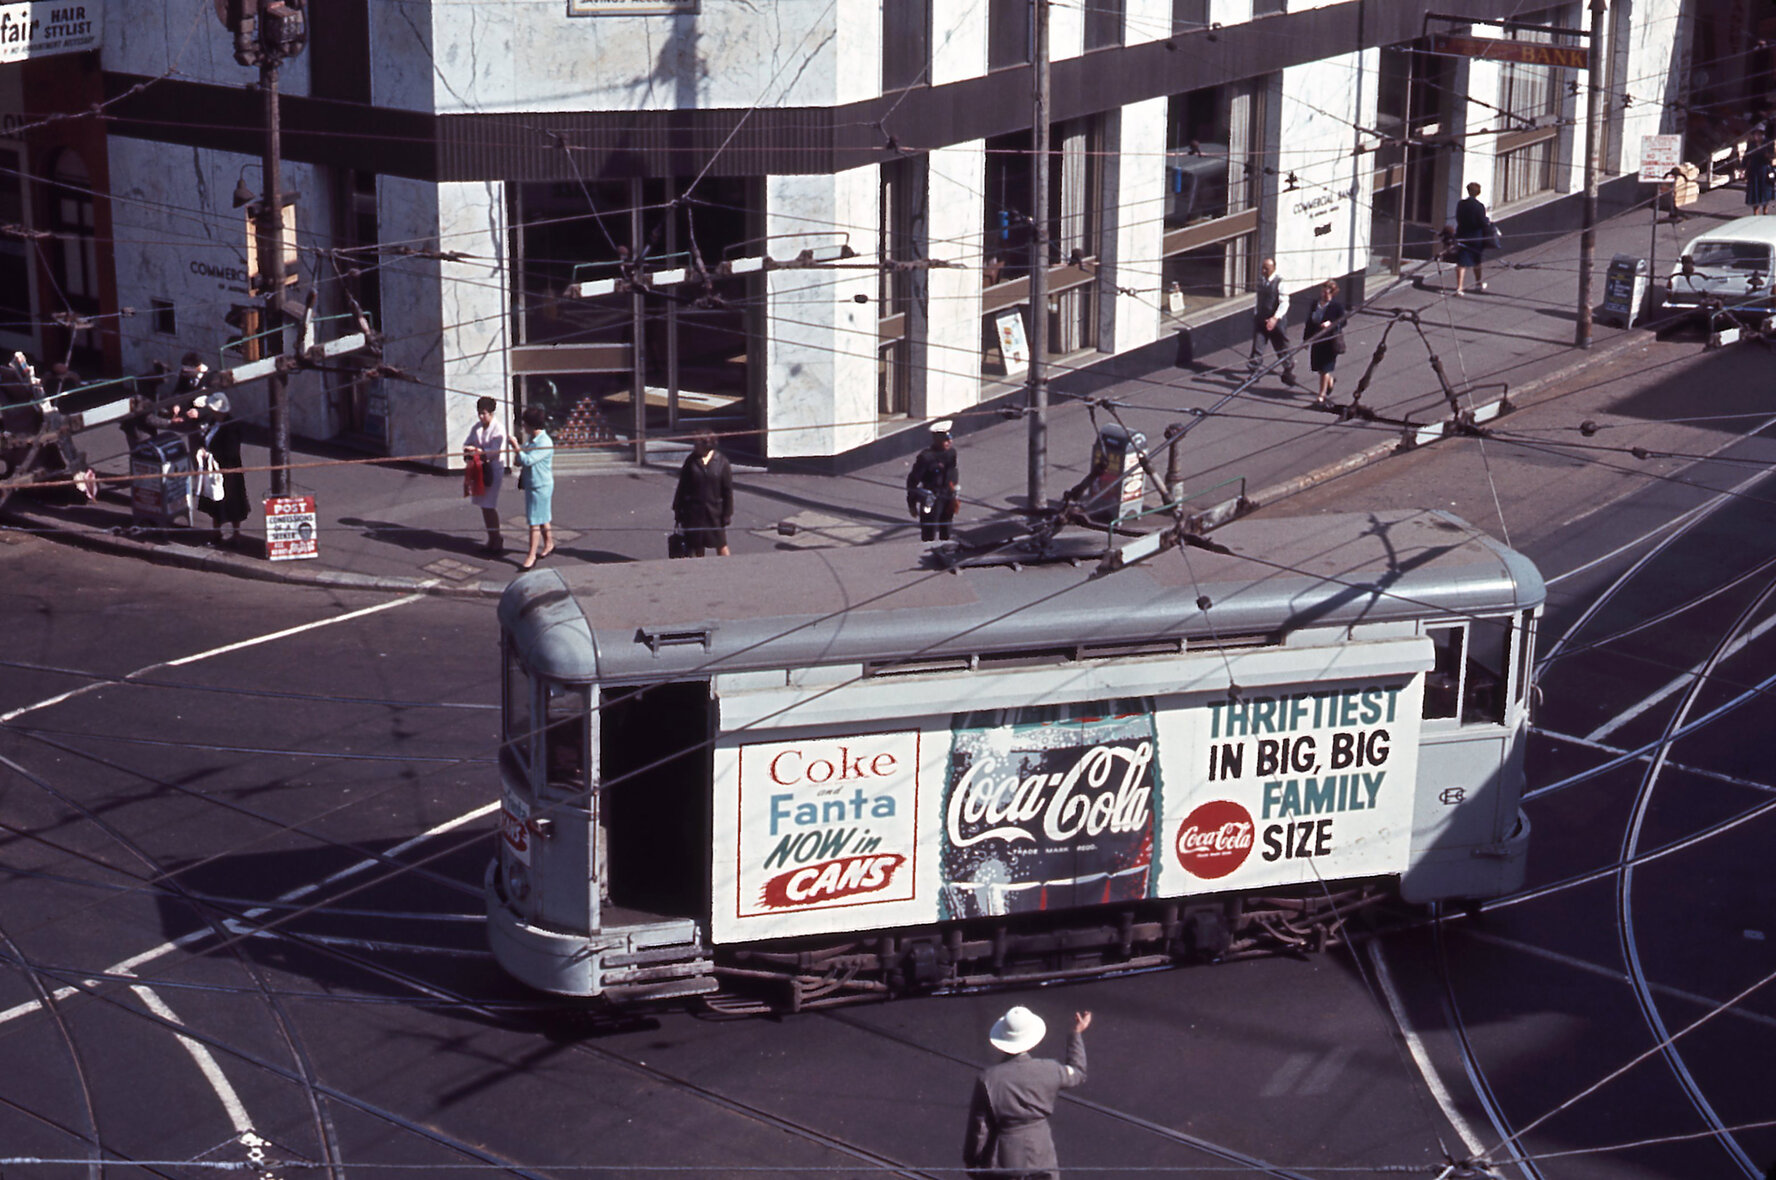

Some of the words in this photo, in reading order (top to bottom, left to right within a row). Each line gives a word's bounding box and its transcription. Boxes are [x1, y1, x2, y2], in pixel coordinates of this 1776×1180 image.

[0, 12, 40, 44] fair
[44, 21, 92, 39] STYLIST
[51, 6, 86, 23] HAIR
[1521, 46, 1584, 67] BANK
[274, 503, 307, 514] POST
[1208, 684, 1404, 738] THRIFTIEST
[768, 746, 897, 786] Coke
[1208, 742, 1244, 781] IN
[1256, 735, 1322, 777] BIG,
[1331, 729, 1390, 770] BIG
[817, 785, 843, 797] and
[948, 741, 1153, 848] Coca-Cola
[1261, 771, 1386, 820] FAMILY
[769, 788, 896, 836] Fanta
[763, 827, 858, 870] NOW
[851, 828, 883, 854] in
[1178, 822, 1251, 855] Coca-Cola
[1262, 819, 1333, 862] SIZE
[786, 857, 897, 901] CANS
